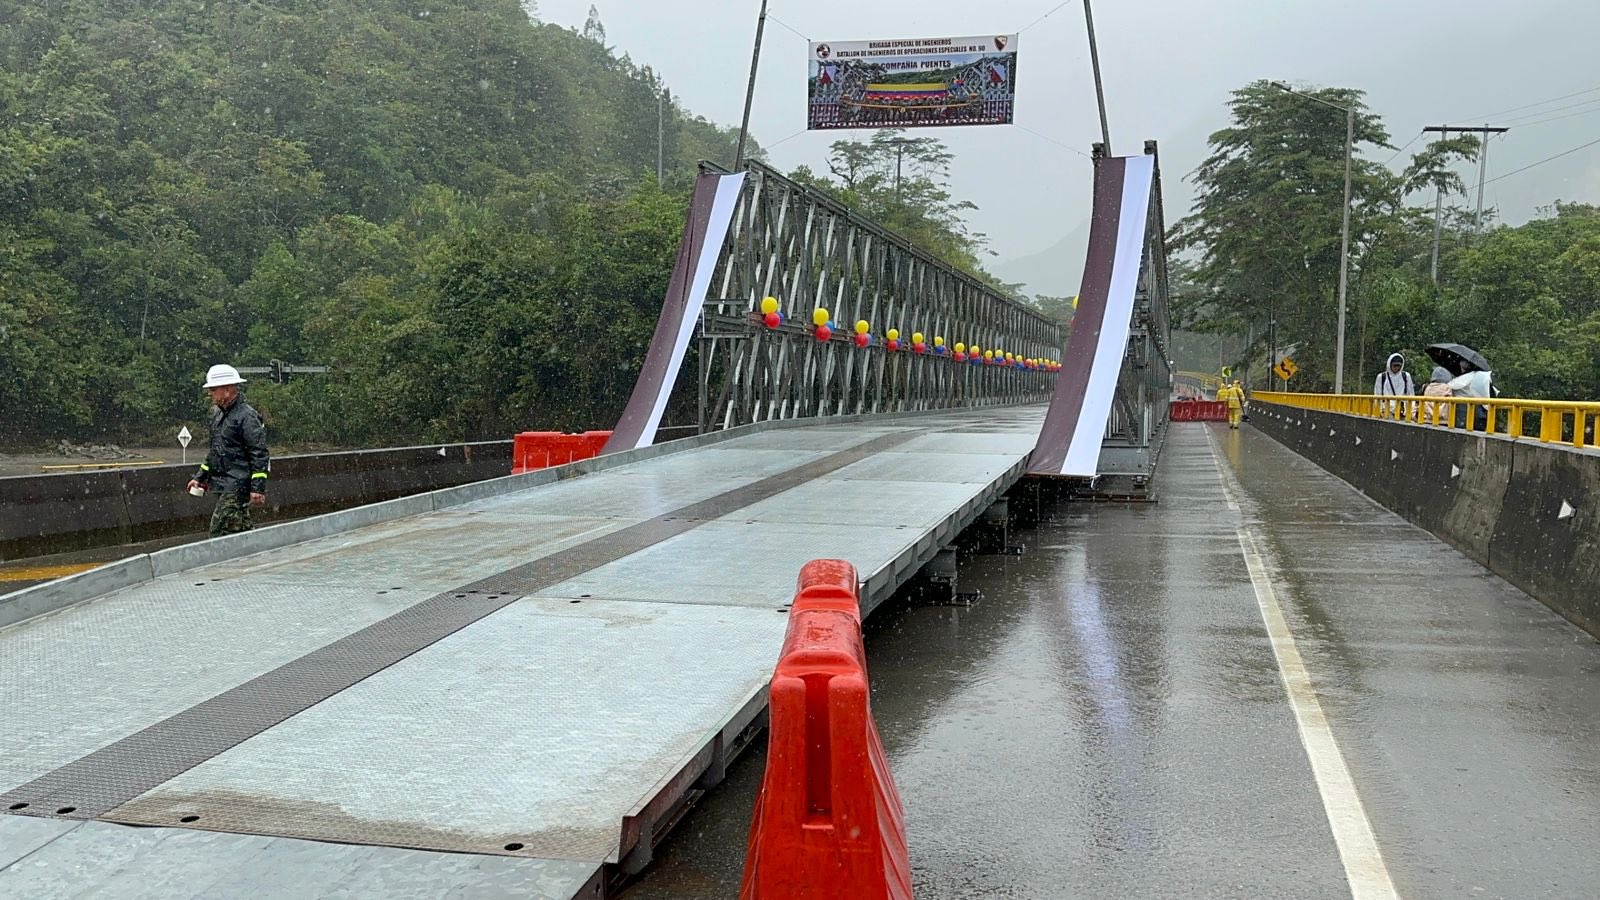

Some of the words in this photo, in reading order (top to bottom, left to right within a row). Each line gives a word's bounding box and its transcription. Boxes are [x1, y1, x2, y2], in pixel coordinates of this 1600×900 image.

[892, 40, 914, 48] ESPECIAL
[904, 47, 937, 55] OPERACIONES
[939, 46, 967, 54] ESPECIALES
[921, 60, 951, 68] PUENTES
